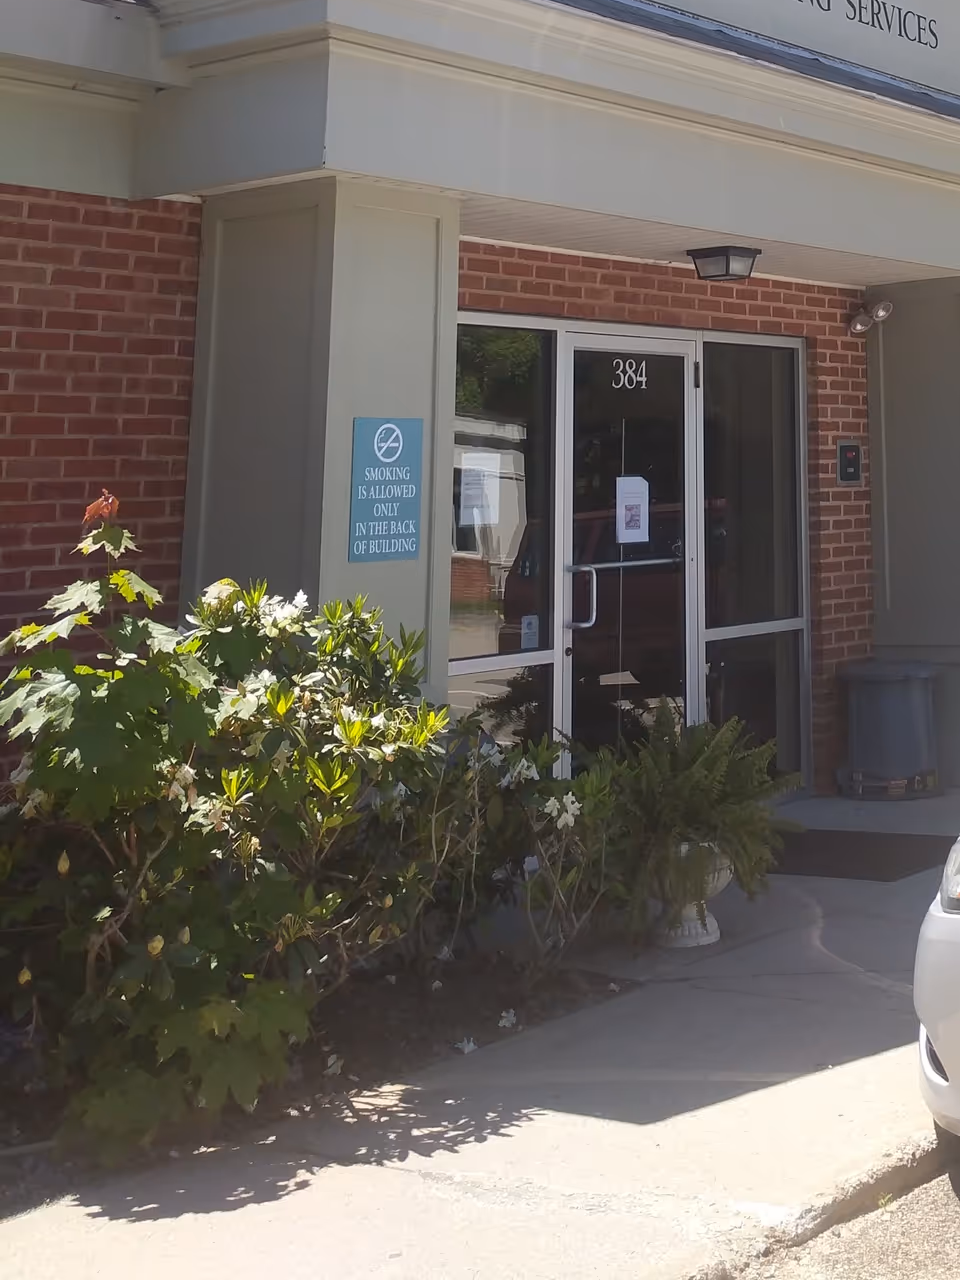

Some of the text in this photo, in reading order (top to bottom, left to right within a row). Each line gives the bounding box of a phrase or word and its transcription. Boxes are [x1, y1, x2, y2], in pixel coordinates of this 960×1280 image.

[612, 358, 647, 389] 384
[364, 467, 410, 481] SMOKING
[358, 484, 416, 499] IS ALLOWED
[373, 503, 400, 517] ONLY
[355, 520, 416, 536] IN THE BACK
[353, 538, 416, 554] OF BUILDING
